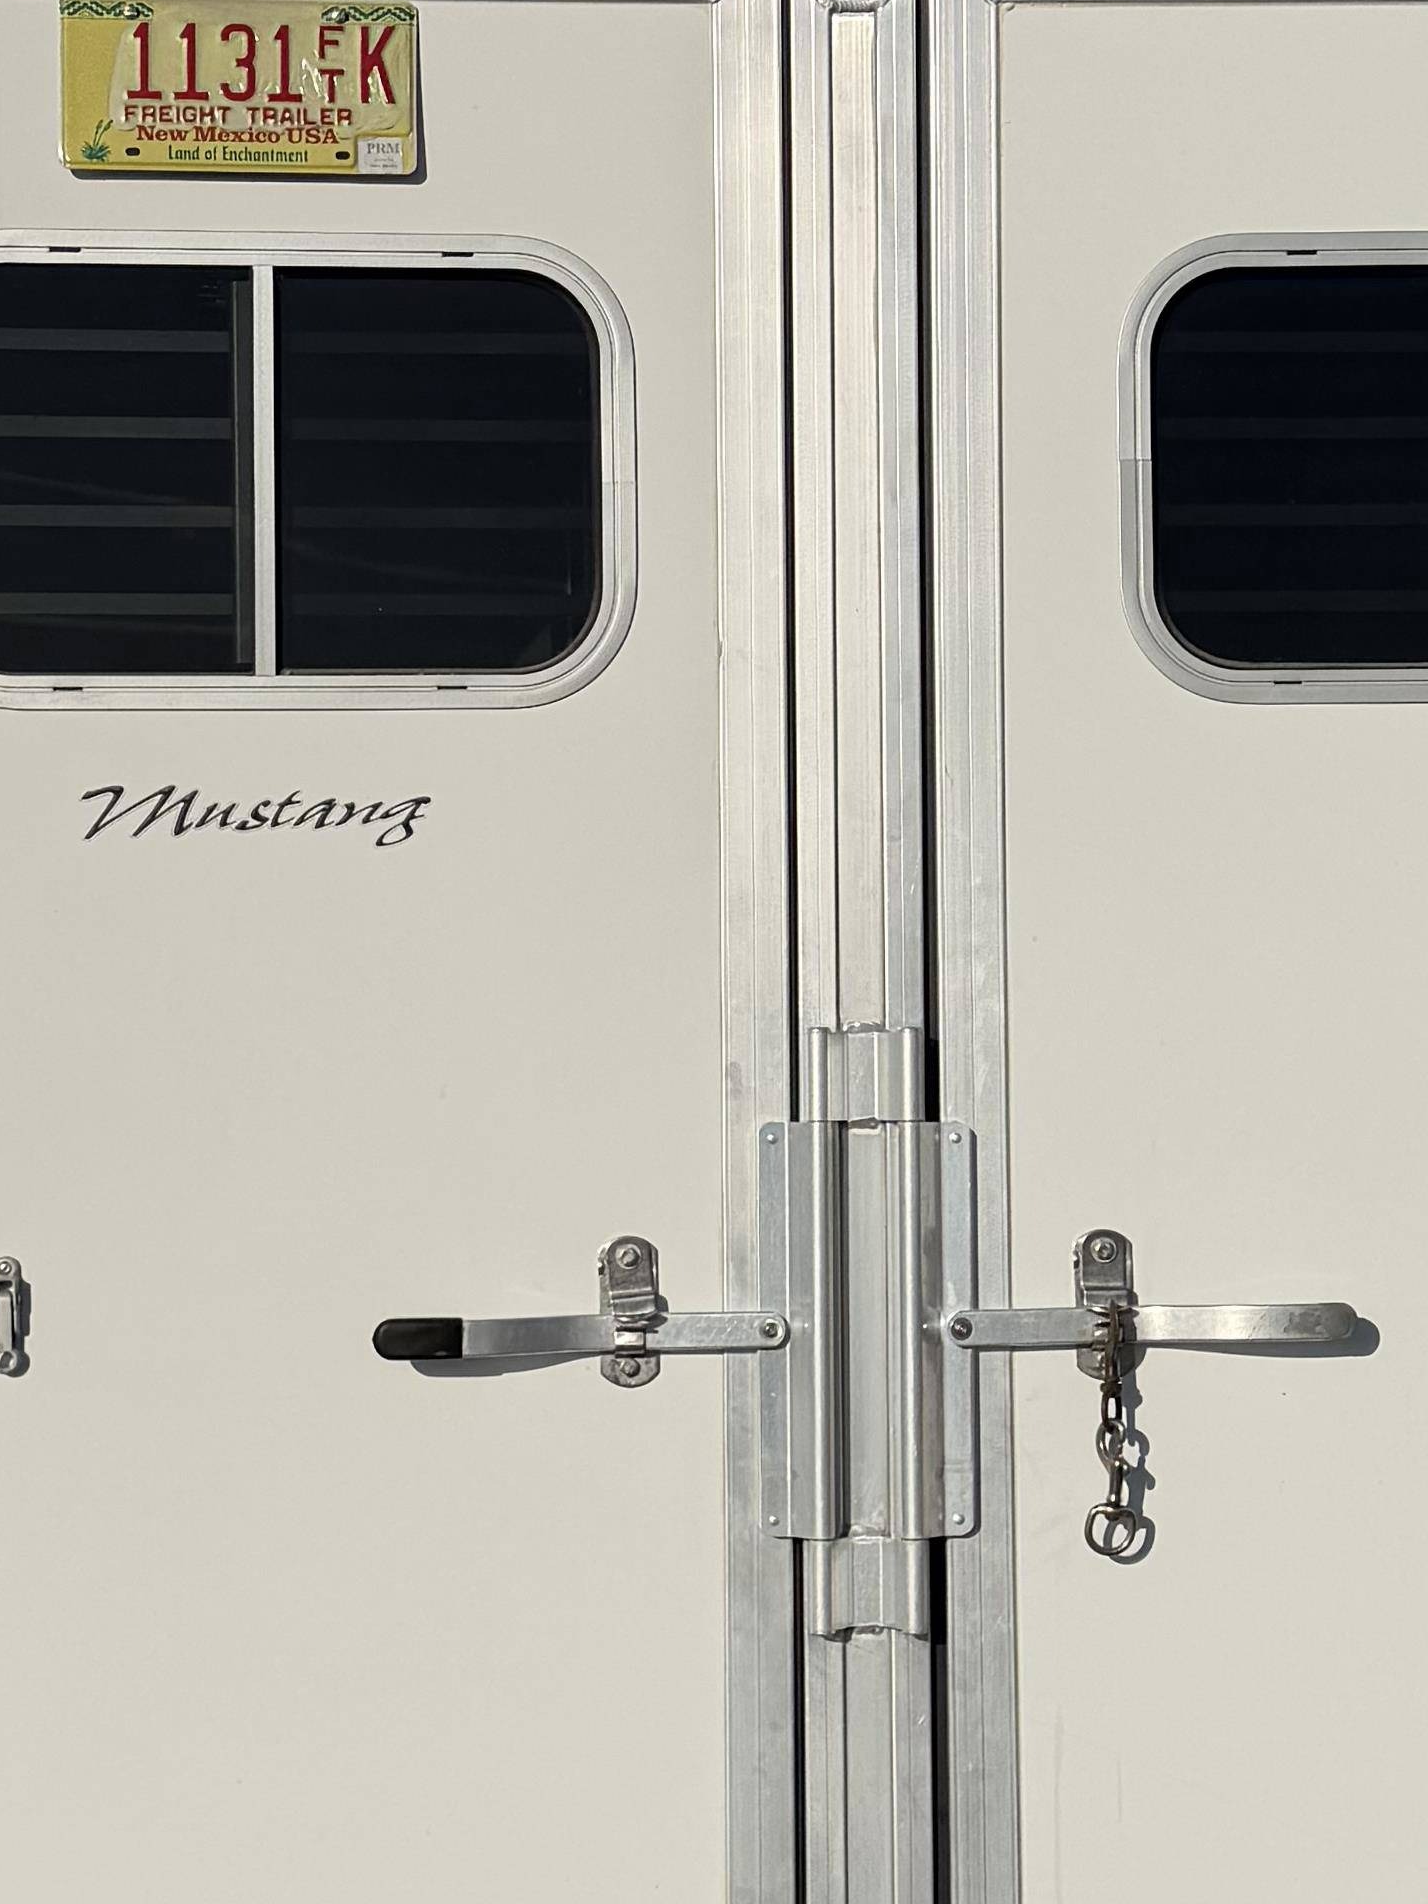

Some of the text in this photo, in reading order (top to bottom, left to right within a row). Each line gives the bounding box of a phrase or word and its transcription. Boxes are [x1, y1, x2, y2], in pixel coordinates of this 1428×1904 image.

[123, 105, 353, 126] FREIGHT TRAILER
[136, 125, 340, 144] New Mexico USA
[168, 146, 309, 163] Land of Enchantment
[80, 784, 432, 847] Mustang
